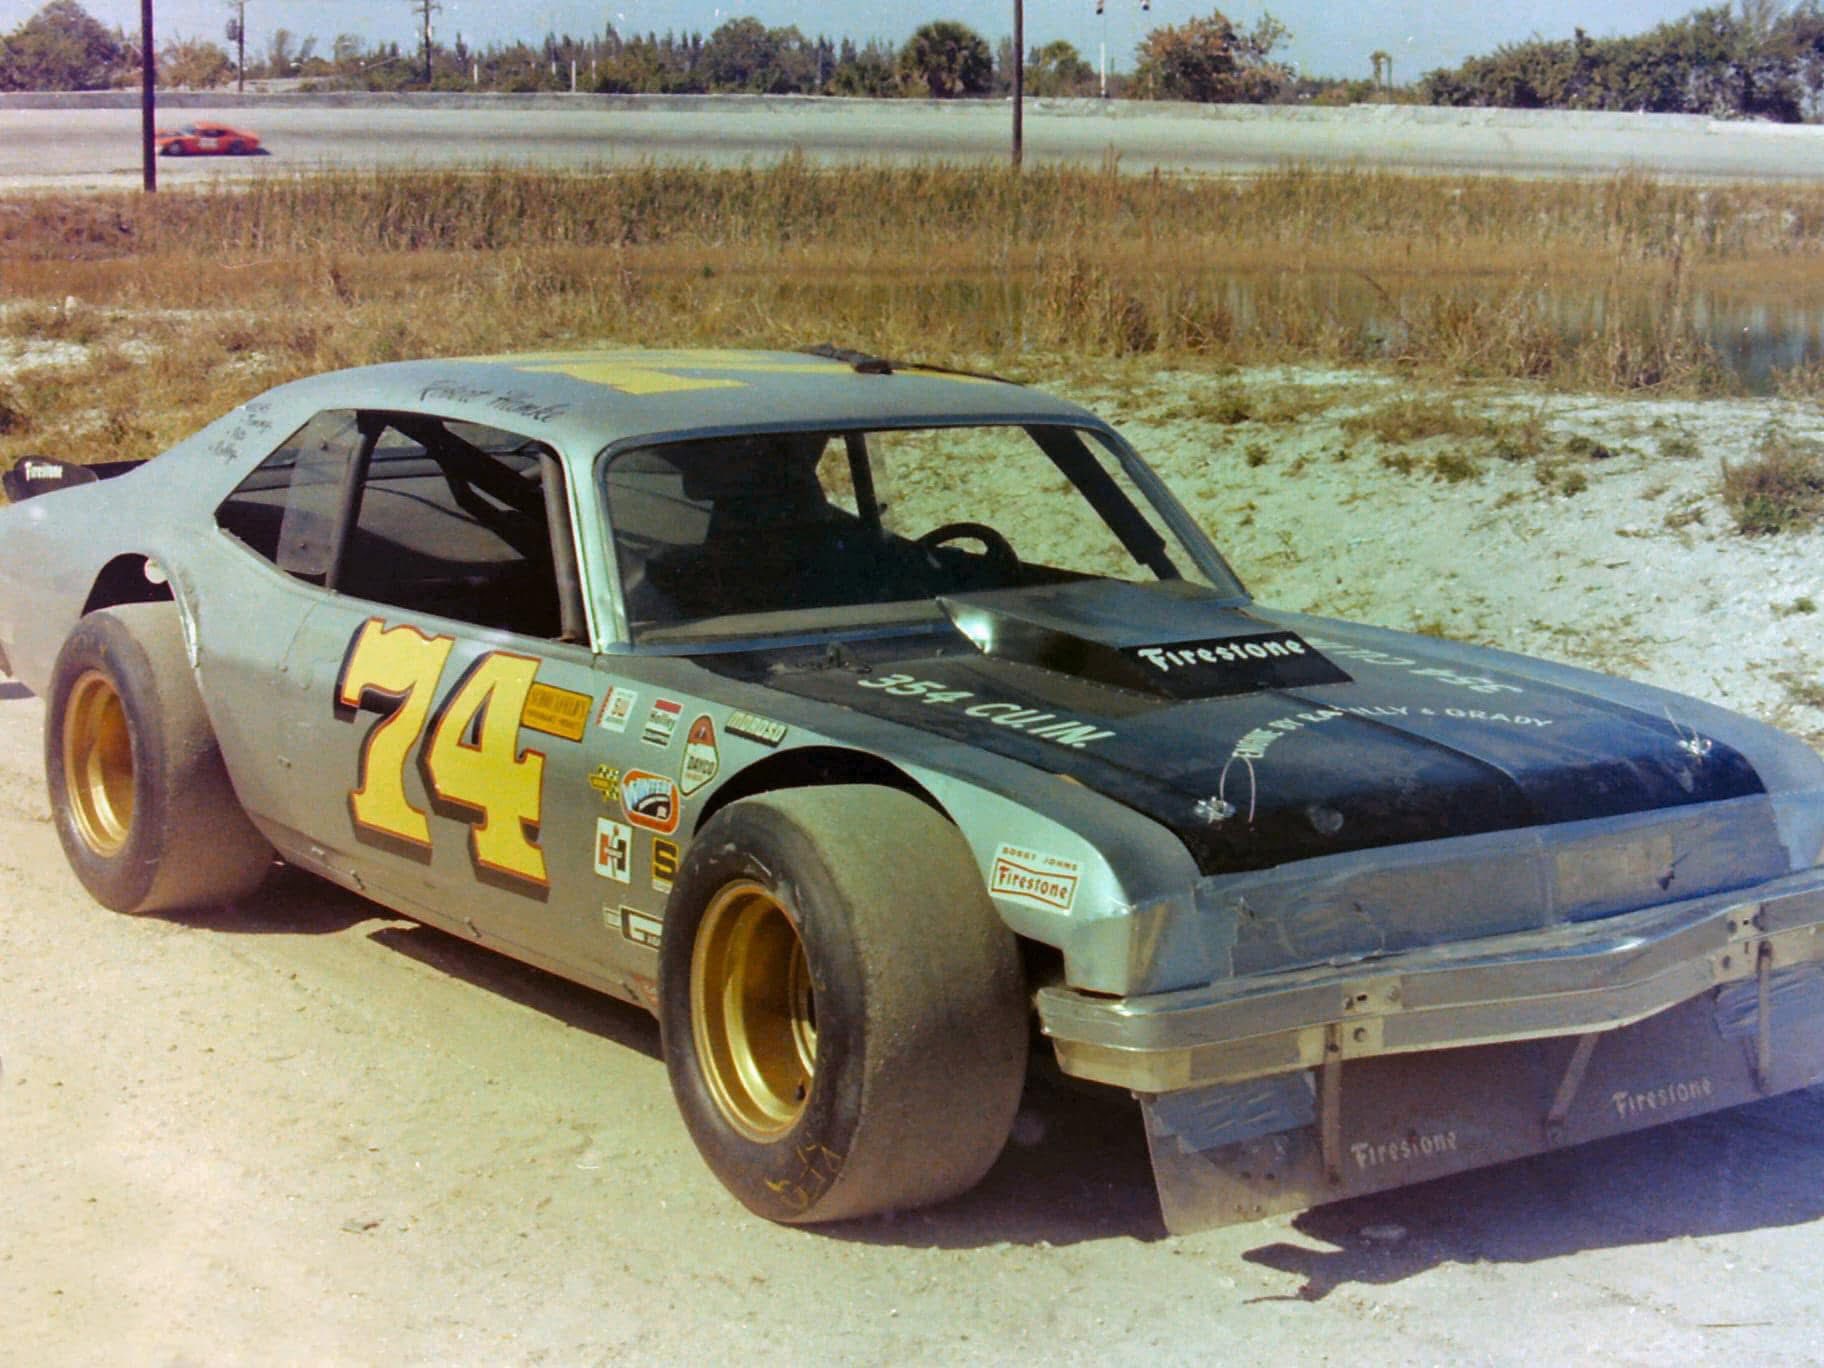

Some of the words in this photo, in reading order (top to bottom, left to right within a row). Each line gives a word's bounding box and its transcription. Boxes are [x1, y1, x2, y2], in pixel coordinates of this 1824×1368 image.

[1137, 639, 1306, 673] Firestone
[857, 673, 976, 704] 354
[335, 617, 551, 900] 74
[998, 865, 1068, 900] Firestone
[1612, 1076, 1714, 1121] Firestone
[1350, 1130, 1458, 1171] Firestone
